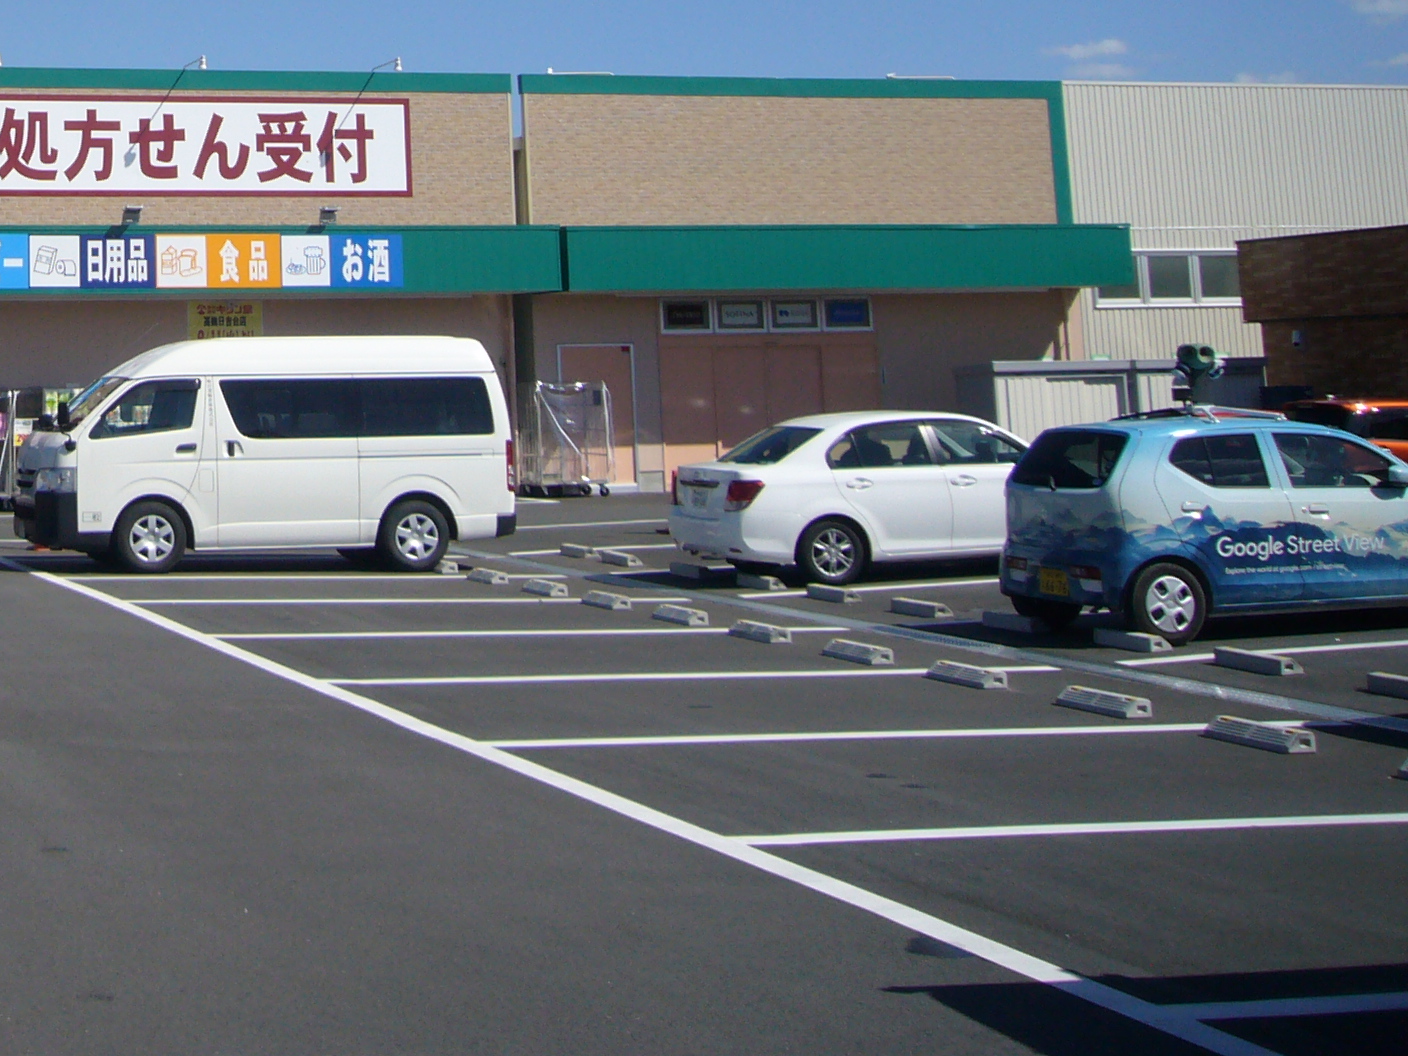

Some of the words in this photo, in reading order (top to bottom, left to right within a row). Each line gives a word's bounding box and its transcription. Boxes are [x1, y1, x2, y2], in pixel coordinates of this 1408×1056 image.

[85, 237, 149, 284] 日用品
[217, 238, 270, 284] 食品
[340, 238, 391, 284] お酒
[1216, 534, 1284, 561] Google
[1286, 534, 1341, 555] Street
[1343, 533, 1385, 551] View
